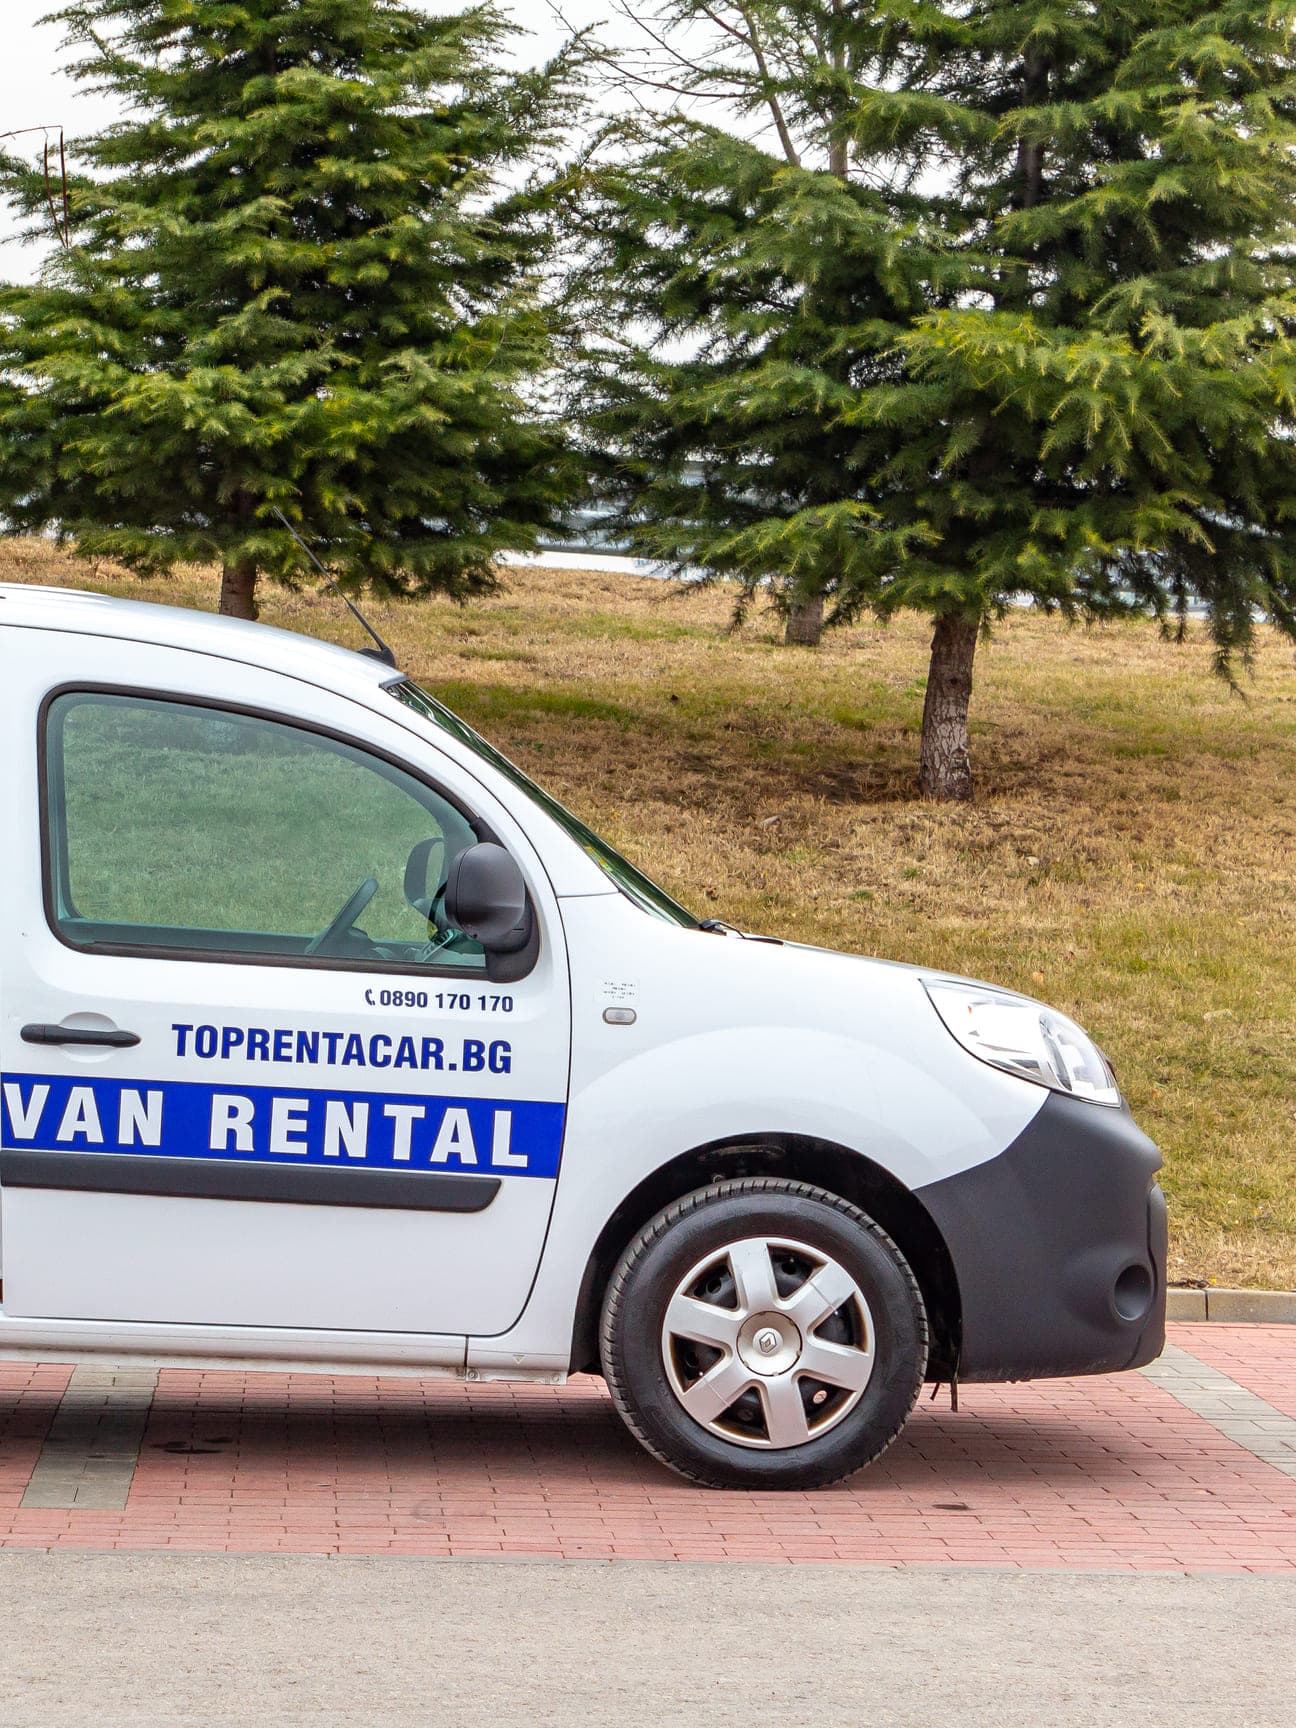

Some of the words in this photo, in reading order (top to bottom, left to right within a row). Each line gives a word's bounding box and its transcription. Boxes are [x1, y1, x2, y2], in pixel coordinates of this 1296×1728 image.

[380, 990, 428, 1008] 0890
[435, 993, 470, 1010] 170
[478, 995, 513, 1012] 170
[171, 1023, 513, 1075] TOPRENTACAR.BG
[3, 1083, 164, 1146] VAN
[209, 1094, 529, 1168] RENTAL
